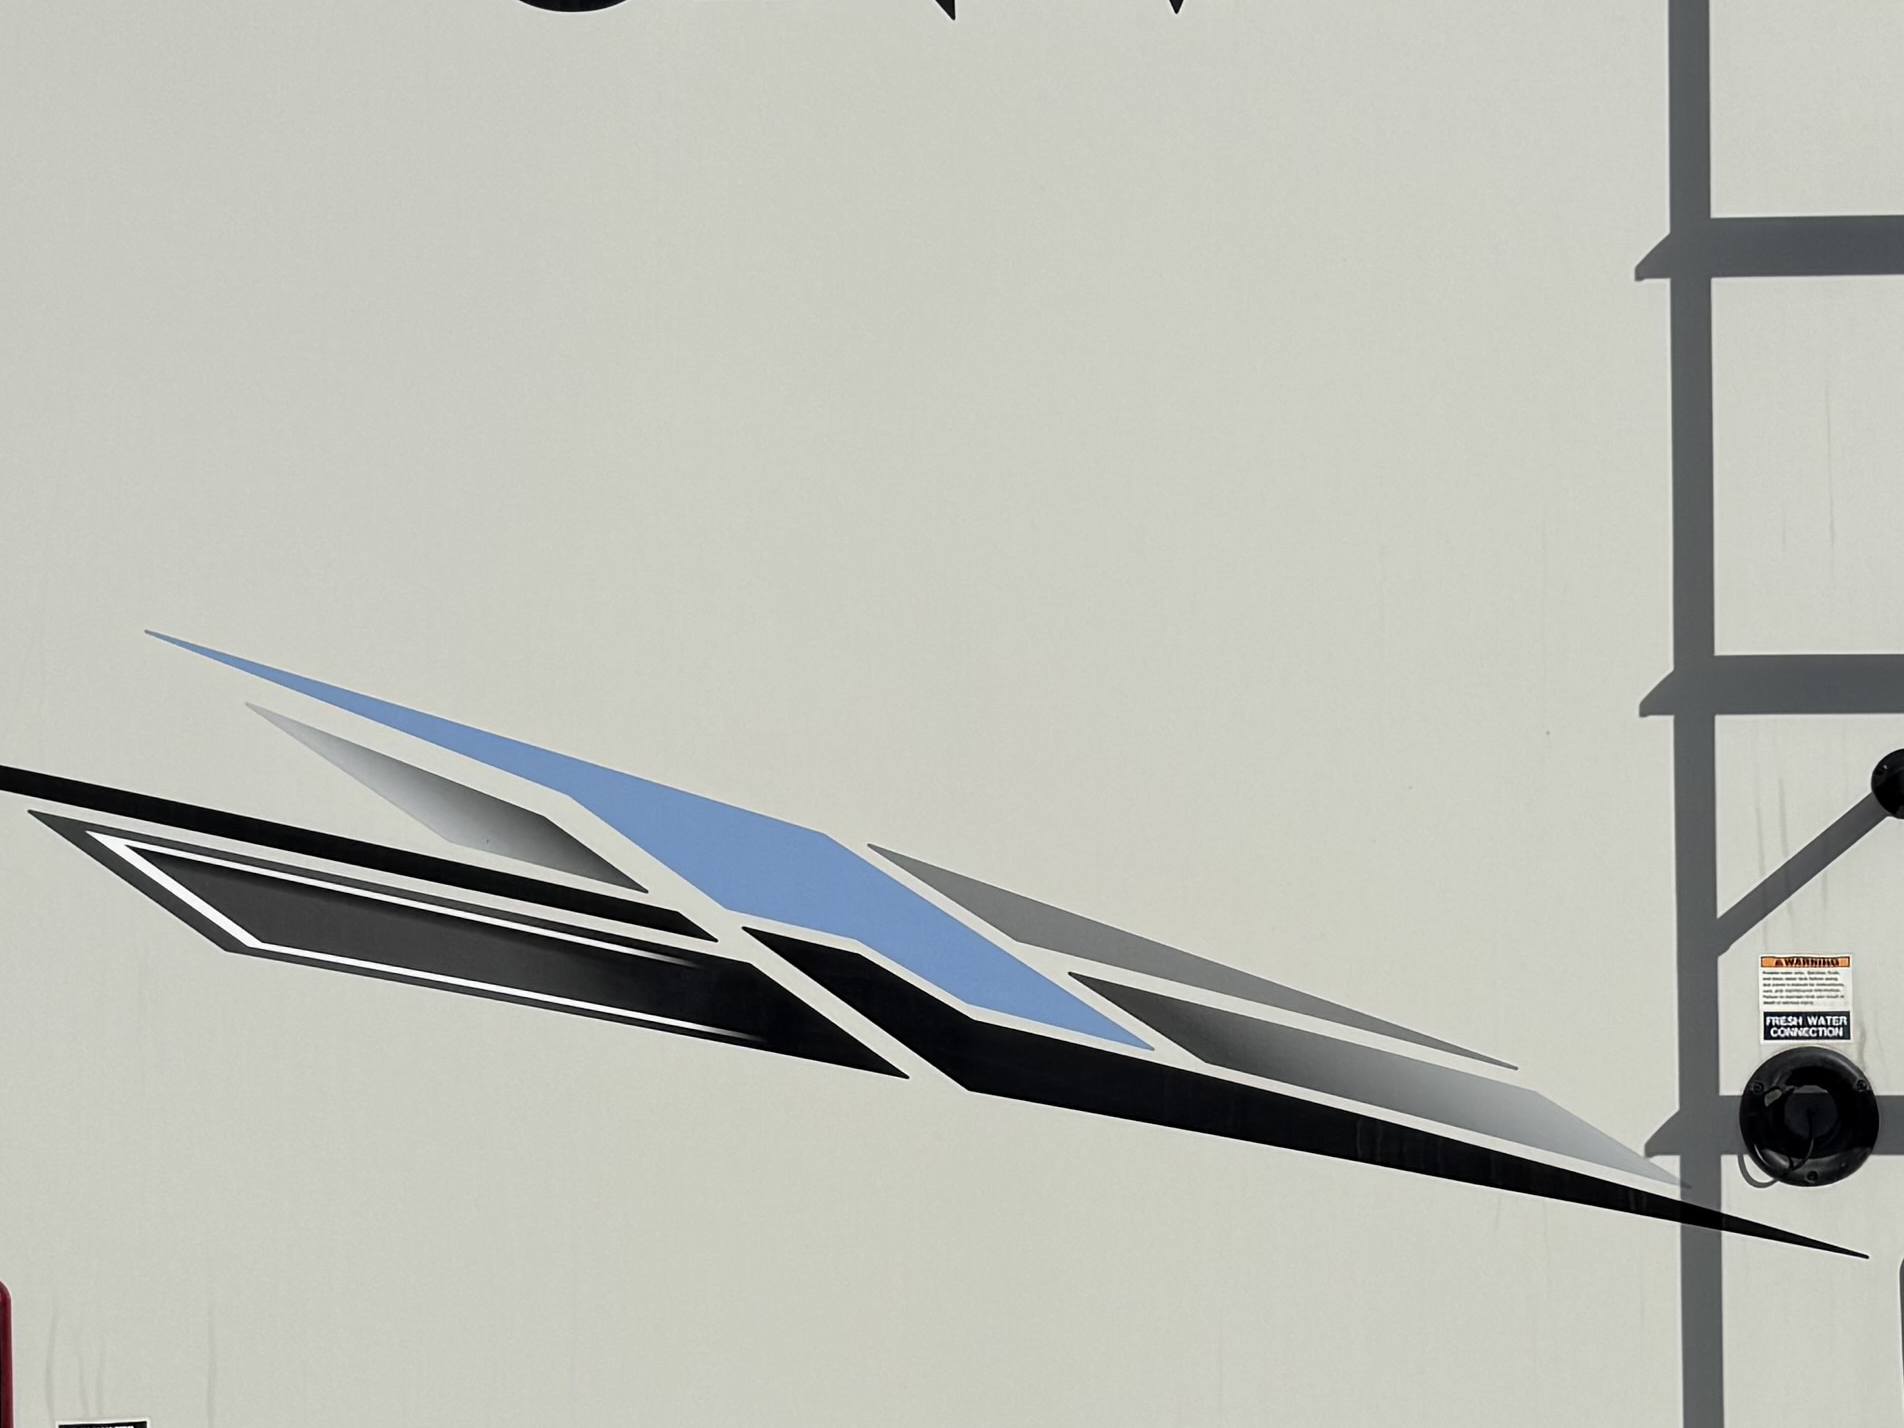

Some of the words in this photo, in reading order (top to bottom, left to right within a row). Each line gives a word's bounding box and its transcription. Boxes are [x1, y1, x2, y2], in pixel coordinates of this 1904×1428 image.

[1784, 958, 1840, 967] WARNING
[1765, 1016, 1803, 1026] FRESH
[1807, 1015, 1848, 1026] WATER
[1770, 1026, 1844, 1038] CONNECTION
